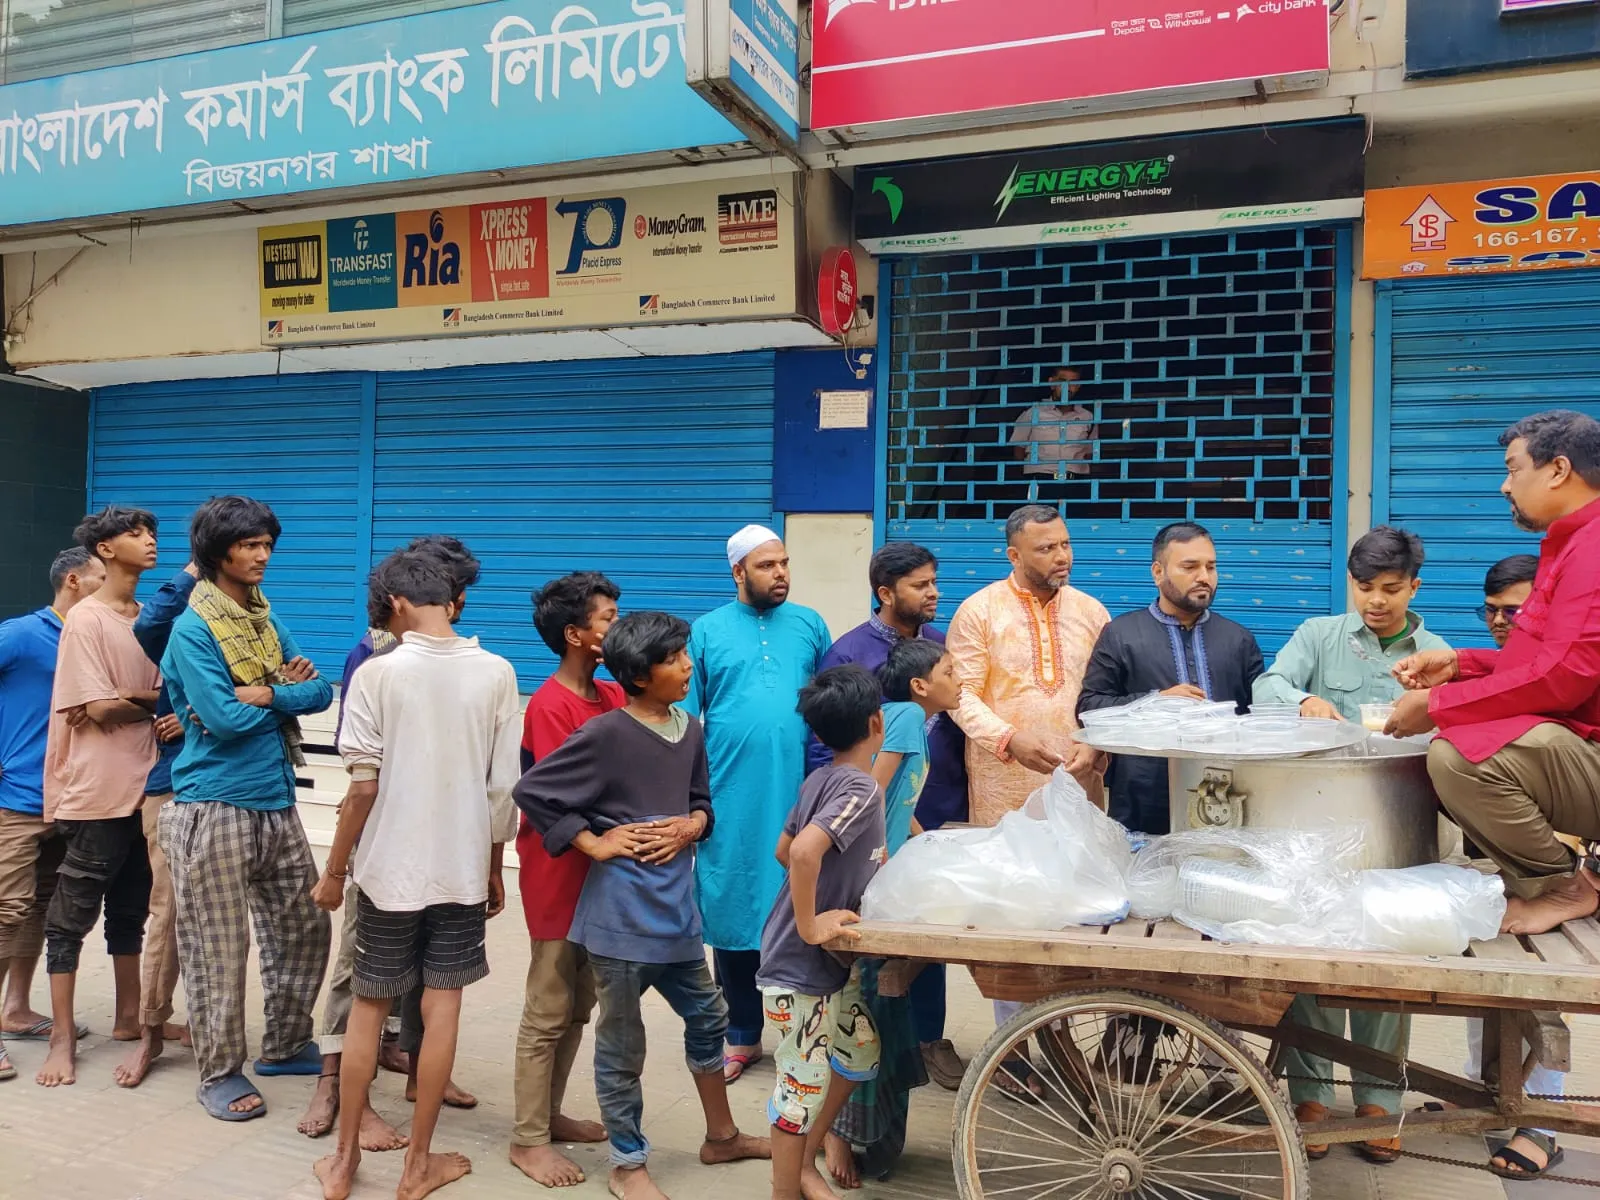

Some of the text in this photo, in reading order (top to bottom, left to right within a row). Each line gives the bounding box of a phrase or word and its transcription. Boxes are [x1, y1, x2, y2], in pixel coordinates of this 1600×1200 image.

[1258, 1, 1281, 14] city
[1113, 25, 1145, 36] Deposit
[1165, 16, 1212, 29] Withdrawal
[0, 87, 169, 175] াংলাদেশ
[181, 45, 318, 146] কমার্স
[325, 47, 469, 127] ব্যাংক
[483, 0, 686, 107] লিমিটে
[183, 136, 432, 196] বিজয়নগর শাখা
[1050, 186, 1172, 204] Efficient Lighting Technology
[728, 197, 776, 225] IME
[1223, 205, 1316, 220] ENERGY+
[480, 206, 528, 241] XPRESS
[648, 213, 705, 239] MoneyGram
[1048, 220, 1129, 234] ENERGY+
[1473, 227, 1587, 248] 166-167,
[264, 243, 297, 263] WESTERN
[402, 209, 461, 289] Ria
[495, 237, 538, 271] MONEY
[275, 262, 297, 281] UNION
[330, 253, 393, 273] TRANSFAST
[582, 256, 622, 269] Placid Express
[661, 293, 776, 309] Bangladesh Commerce Bank Limited
[463, 307, 564, 322] Bangladesh Commerce Bank Limited
[287, 325, 315, 334] Bangladesh
[356, 320, 376, 328] Limited
